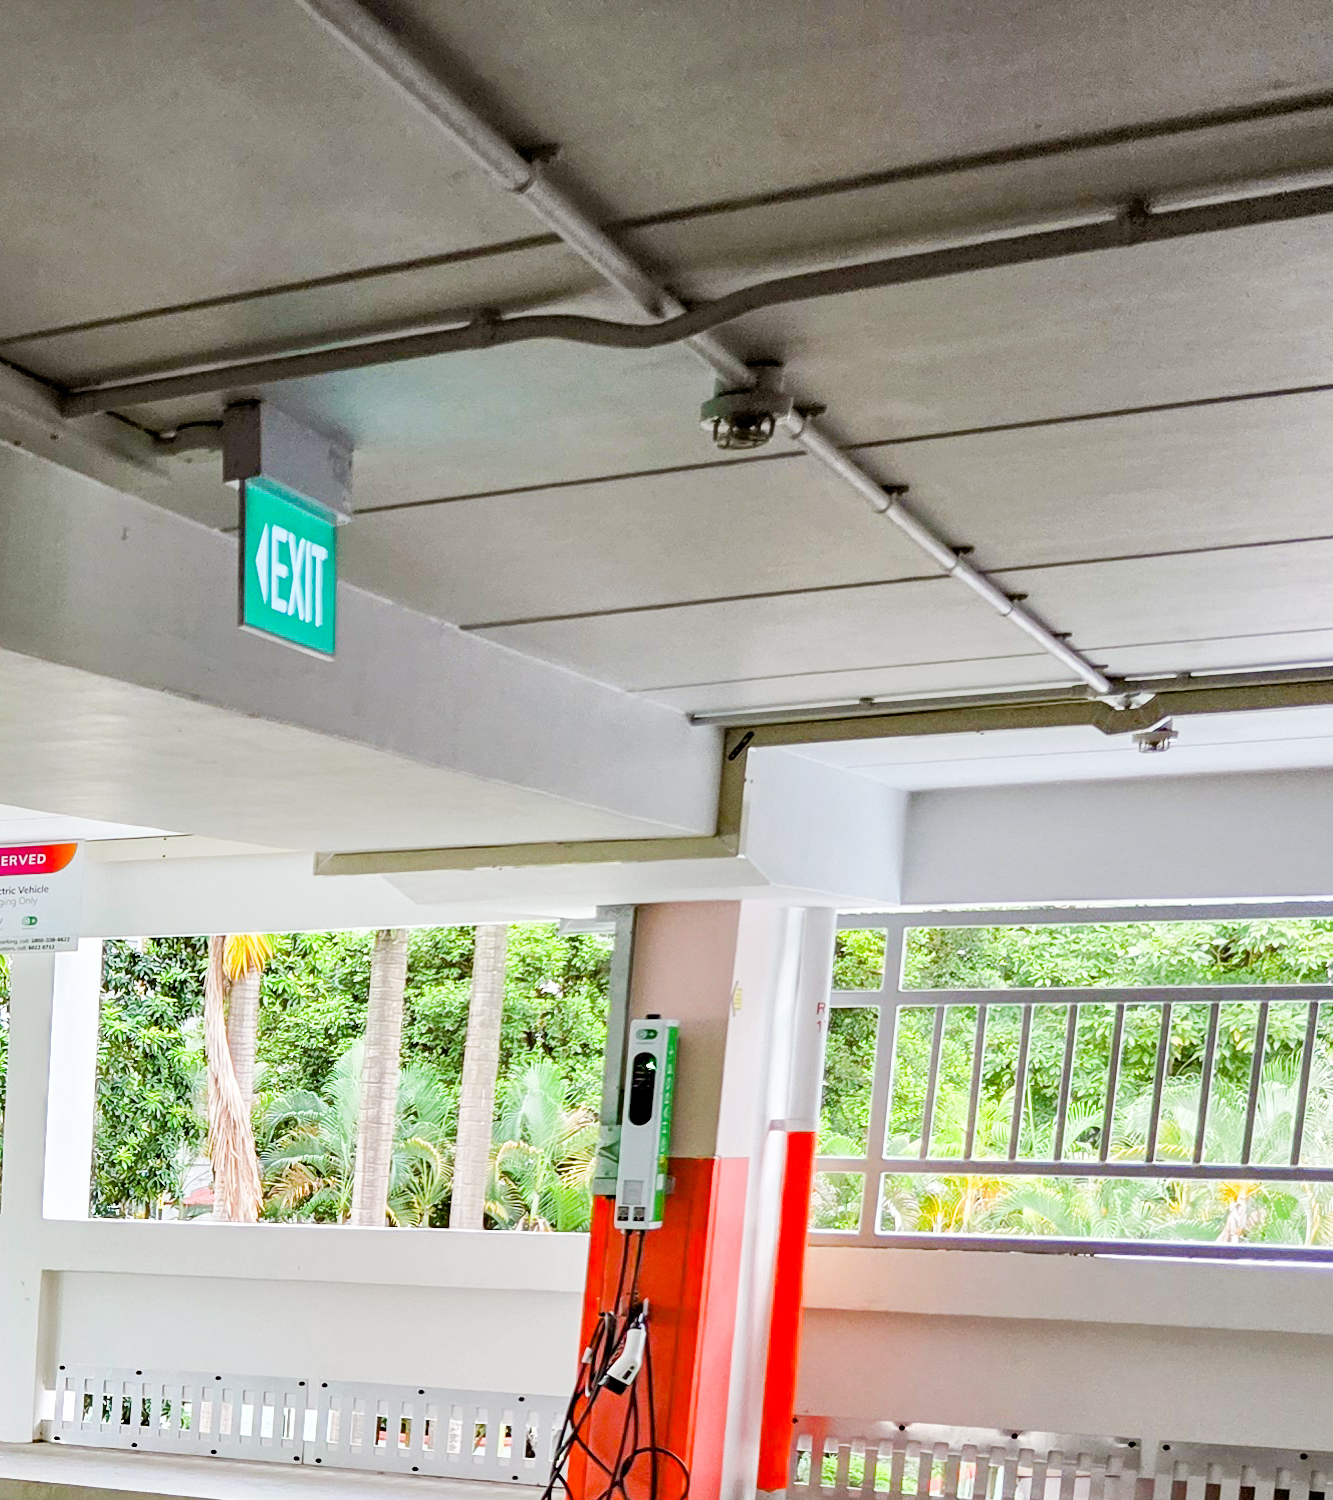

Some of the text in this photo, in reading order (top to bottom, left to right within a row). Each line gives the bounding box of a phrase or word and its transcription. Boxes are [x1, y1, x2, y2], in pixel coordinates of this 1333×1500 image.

[271, 524, 329, 628] EXIT
[18, 885, 49, 894] Vehicle
[19, 896, 38, 906] Only
